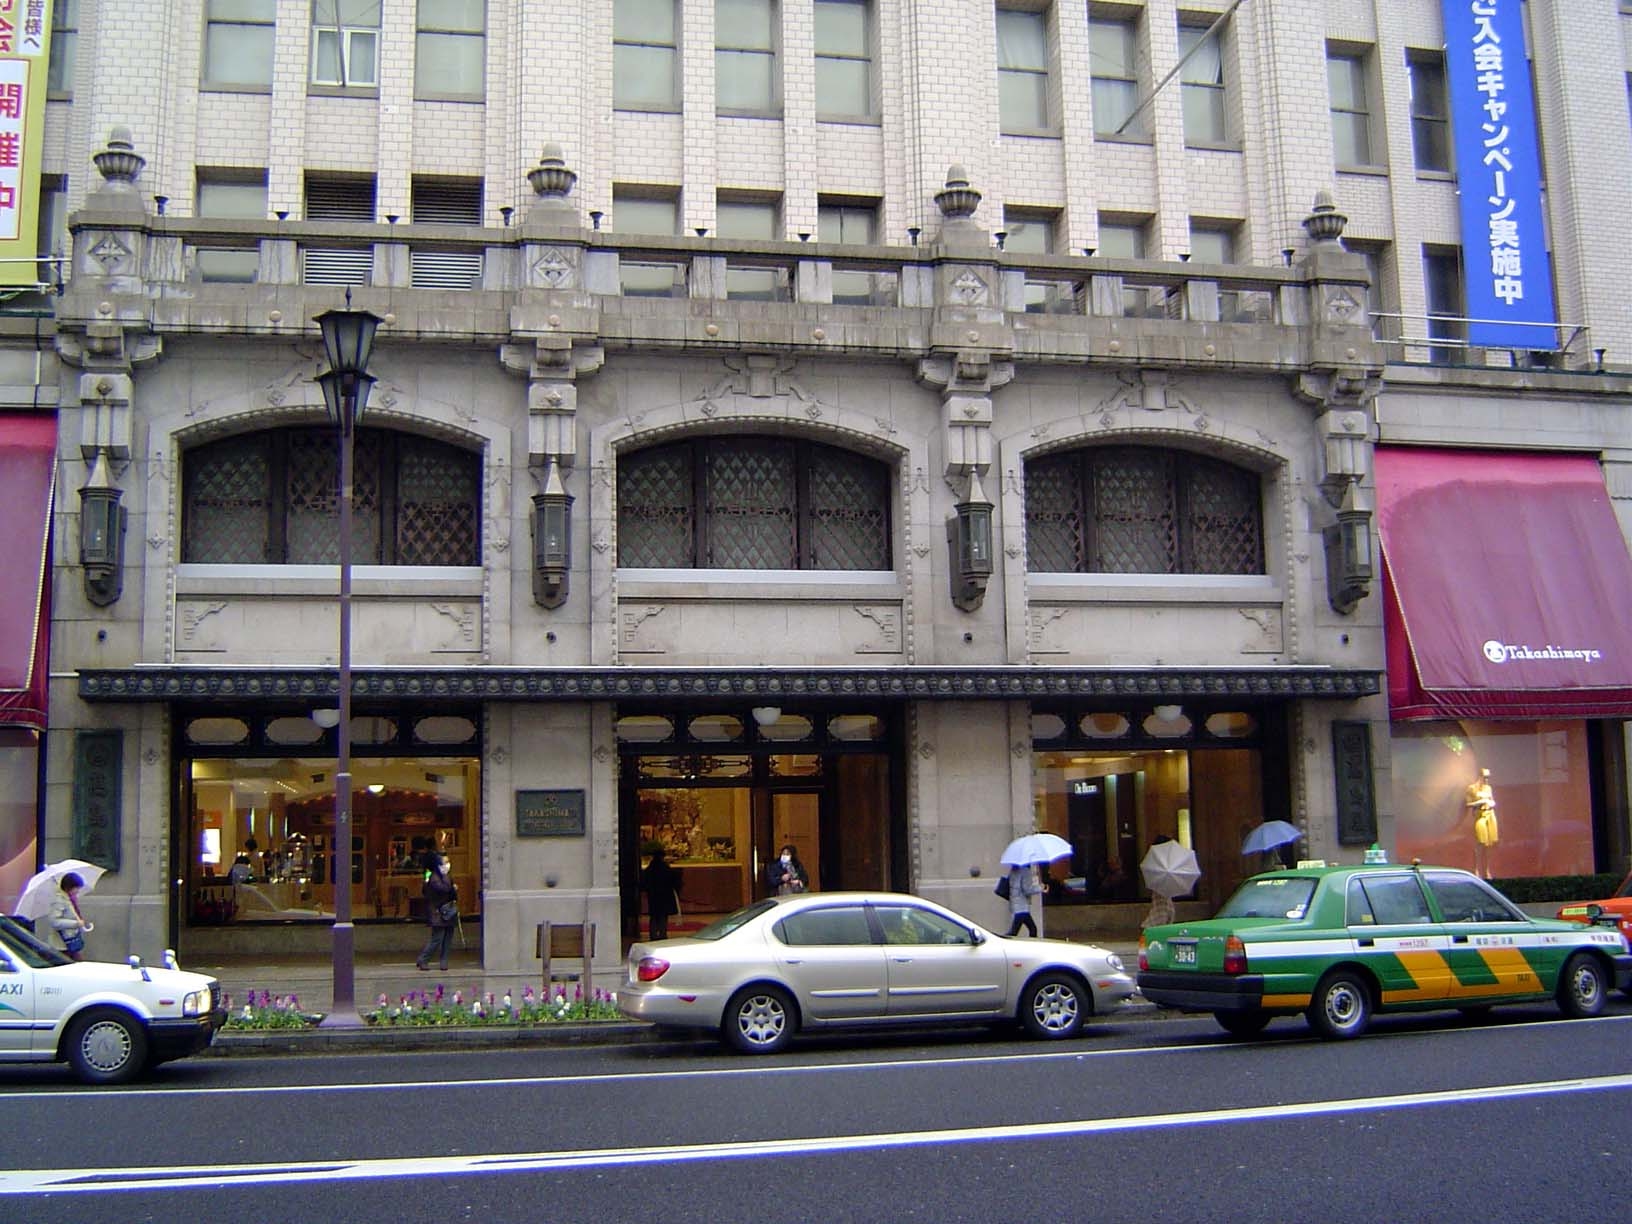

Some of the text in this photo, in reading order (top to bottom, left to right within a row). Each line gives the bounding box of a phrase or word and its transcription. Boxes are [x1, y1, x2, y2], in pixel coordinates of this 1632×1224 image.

[1471, 0, 1524, 305] ご入会キャンペーン実施中
[1505, 644, 1601, 663] Takashimaya
[0, 983, 24, 995] AXI
